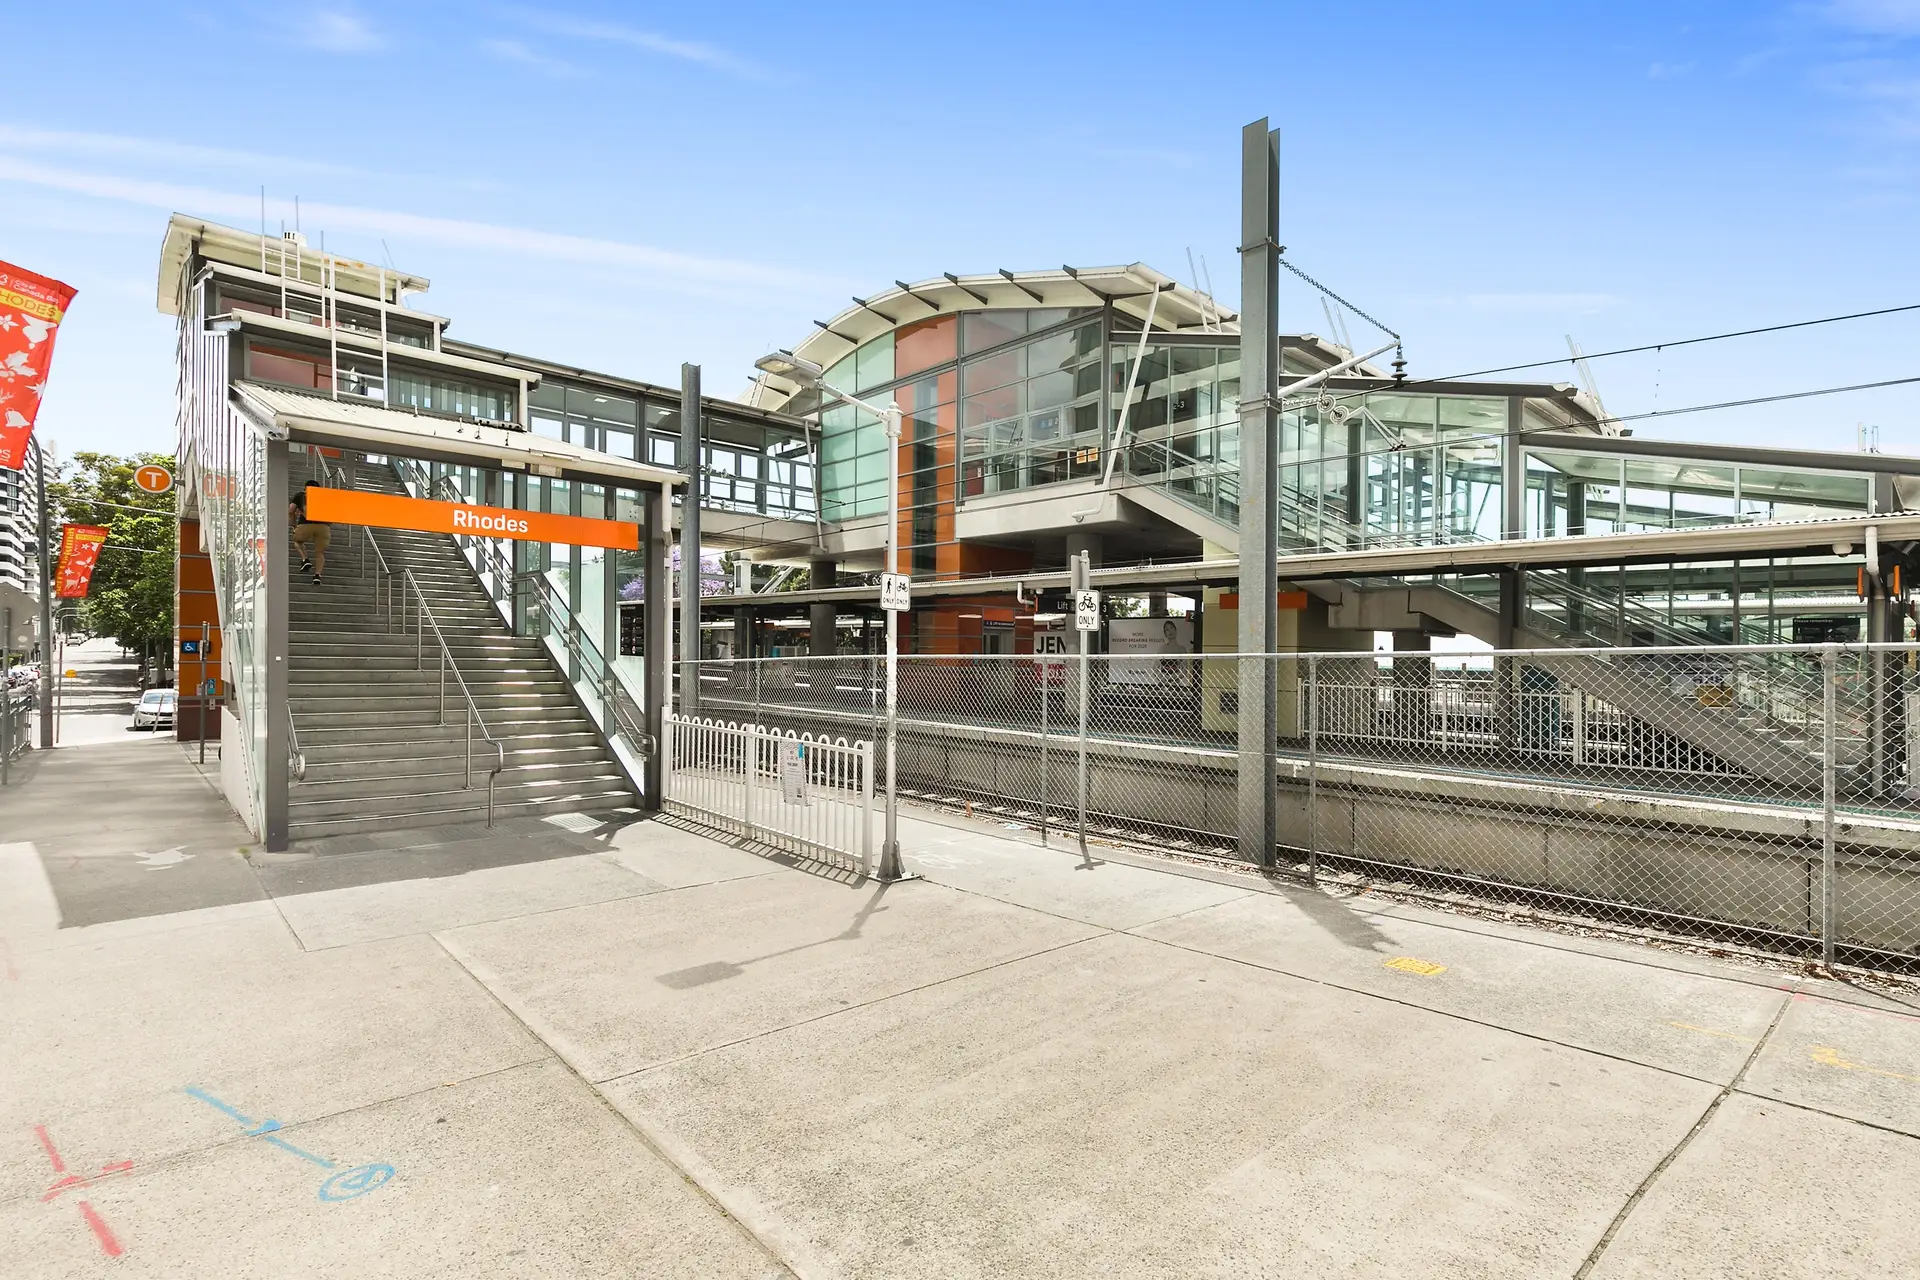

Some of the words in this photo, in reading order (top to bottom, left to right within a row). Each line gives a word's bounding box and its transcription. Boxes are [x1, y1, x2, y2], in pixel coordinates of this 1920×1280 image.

[145, 471, 163, 488] T
[453, 509, 529, 533] Rhodes
[1057, 600, 1069, 610] Lift
[1078, 615, 1095, 625] ONLY
